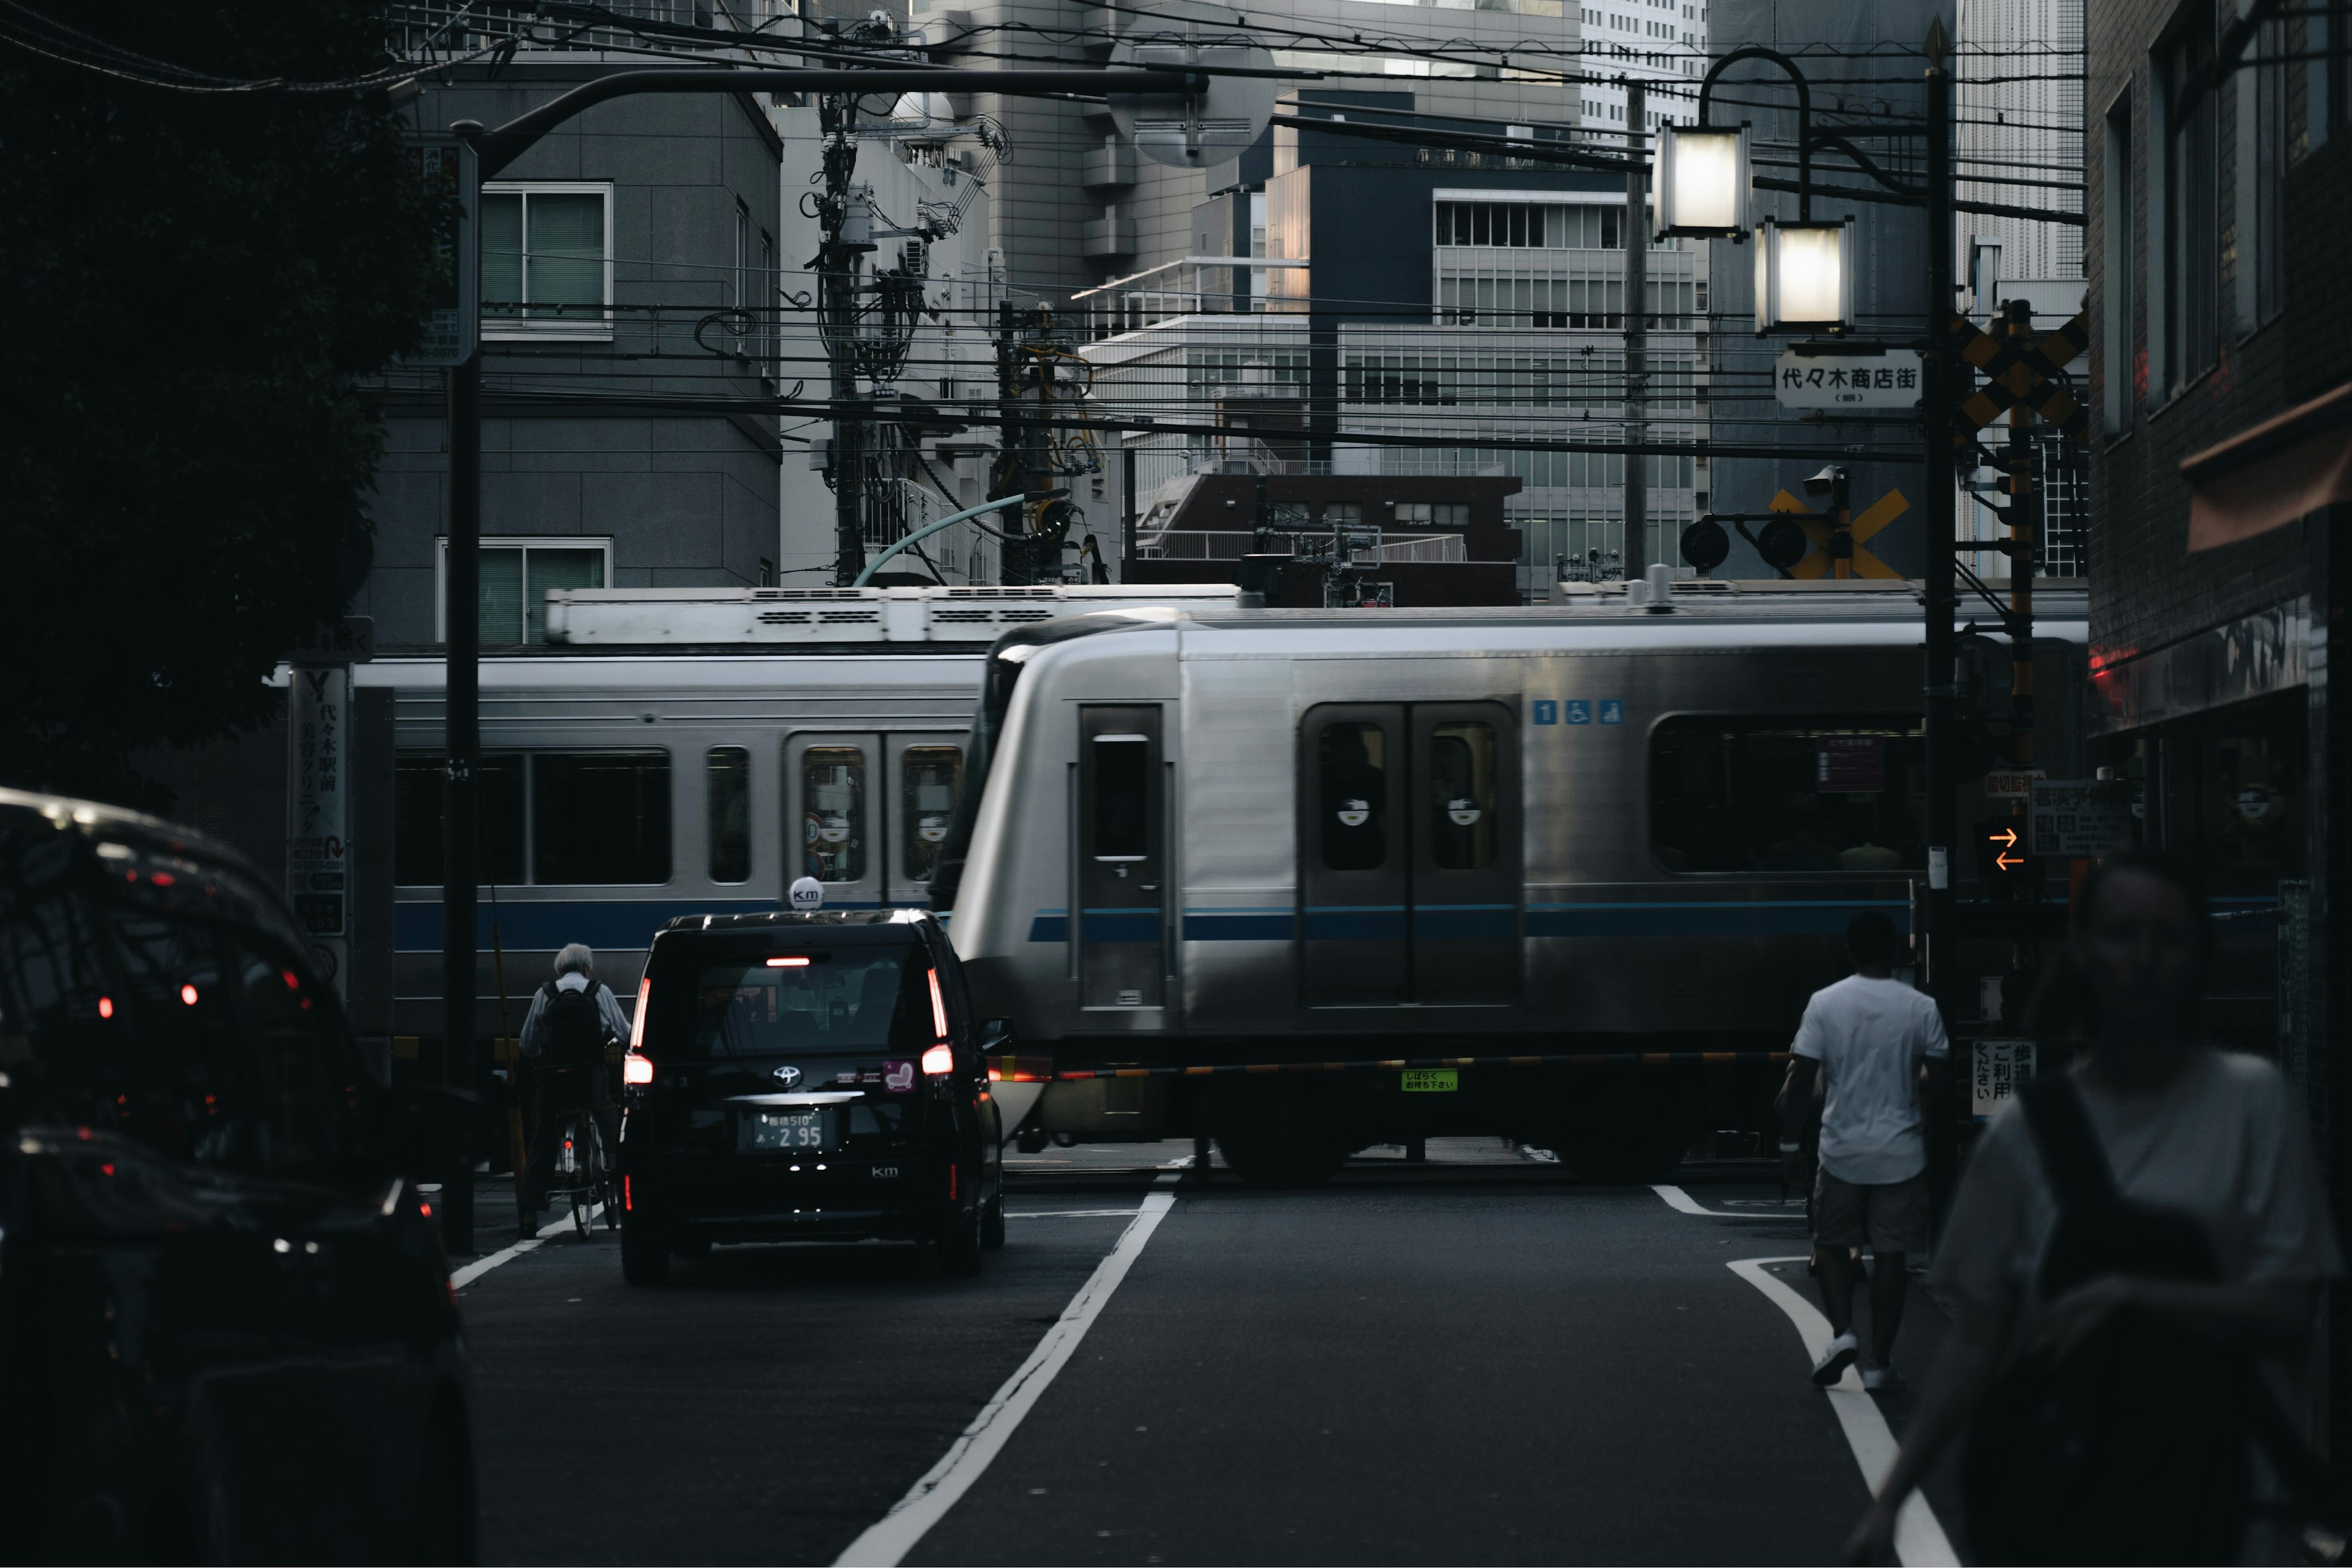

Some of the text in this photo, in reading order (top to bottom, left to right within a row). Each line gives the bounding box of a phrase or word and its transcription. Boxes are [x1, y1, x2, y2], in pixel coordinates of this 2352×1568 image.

[1783, 368, 1917, 390] 代々木商店街
[320, 704, 337, 792] 代々木駅前
[1977, 1045, 1990, 1100] ください
[1993, 1044, 2011, 1100] ご利用
